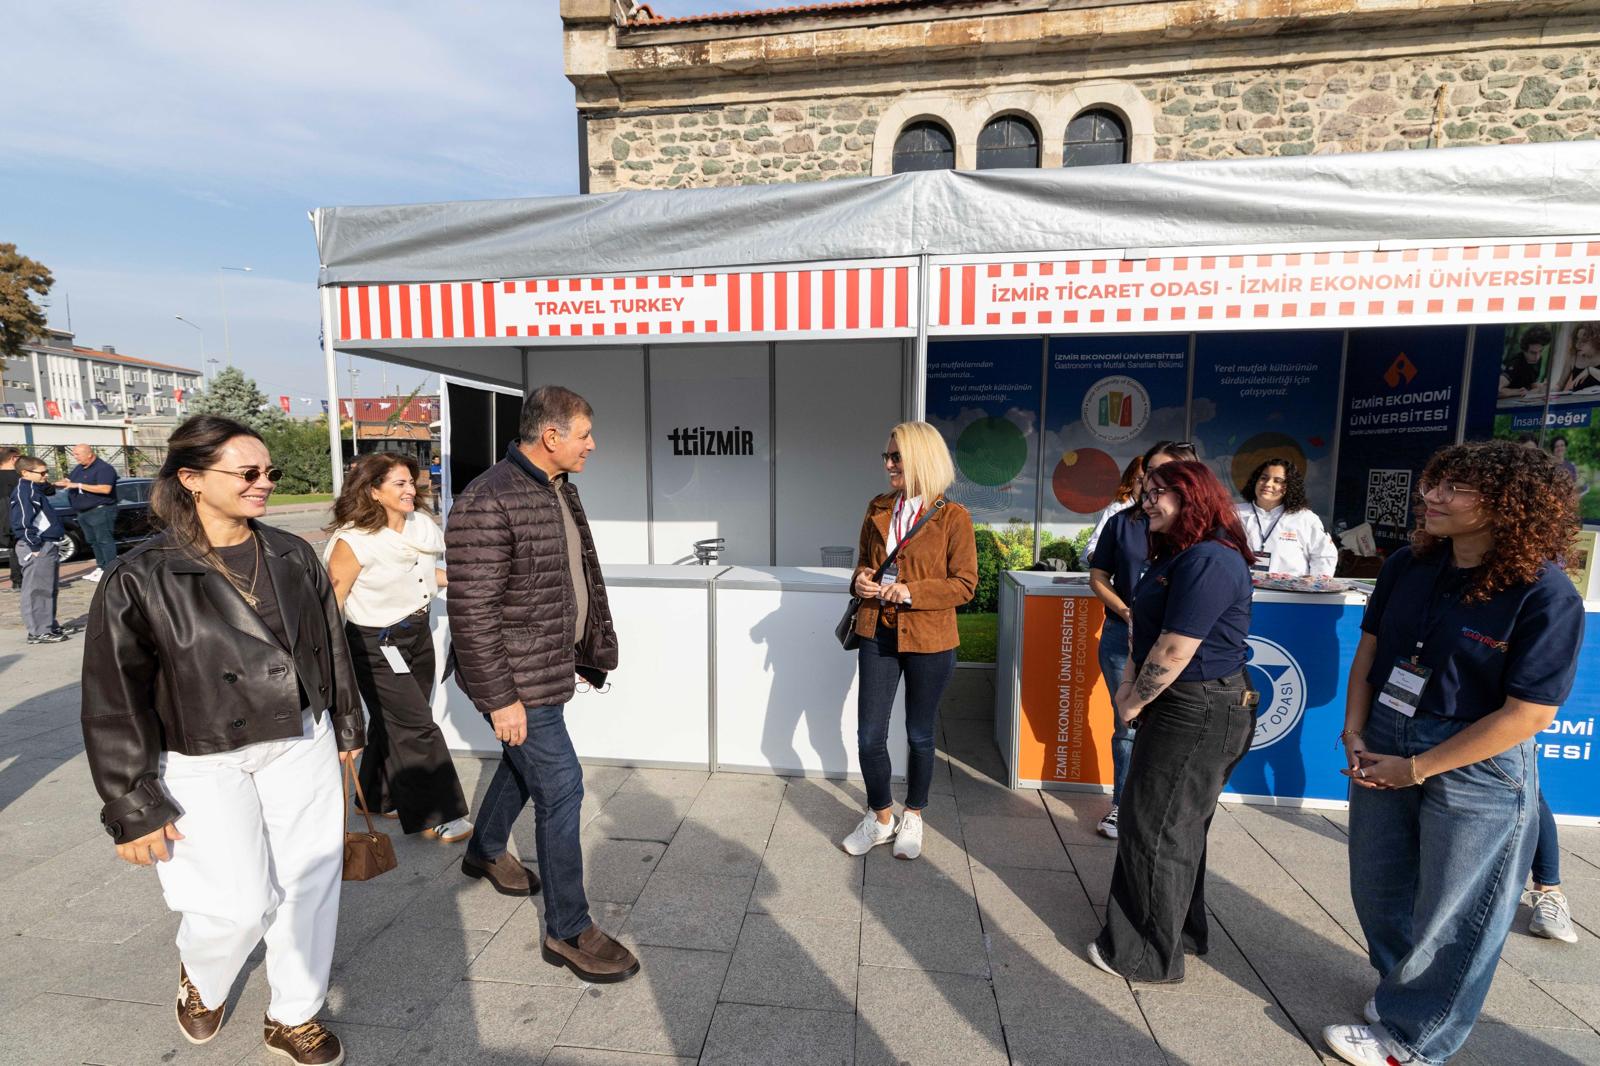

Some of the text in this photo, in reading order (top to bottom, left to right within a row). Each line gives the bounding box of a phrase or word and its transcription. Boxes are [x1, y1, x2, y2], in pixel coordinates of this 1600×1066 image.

[991, 283, 1049, 302] İZMİR
[1055, 280, 1144, 300] TİCARET
[1150, 279, 1218, 297] ODASI
[1239, 273, 1303, 295] İZMİR
[1309, 269, 1421, 292] EKONOMİ
[1429, 263, 1595, 288] ÜNİVERSİTESİ
[535, 297, 685, 316] TRAVEL TURKEY
[1054, 351, 1185, 361] İZMİR EKONOMİ ÜNİVERSİTESİ
[1215, 362, 1319, 374] Yerel mutfak kültürünün
[950, 383, 967, 392] Yerel
[968, 383, 993, 393] mutfak
[1294, 375, 1311, 386] için
[1351, 385, 1452, 409] İZMİR EKONOMİ
[1349, 405, 1450, 426] ÜNİVERSİTESİ
[1545, 411, 1588, 426] Değer
[1076, 598, 1088, 666] ECONOMICS
[1075, 667, 1085, 683] OF
[1053, 597, 1075, 779] İZMİR EKONOMİ ÜNİVERSİTESİ
[1270, 682, 1294, 725] ODASI
[1071, 686, 1085, 748] UNIVERSITY
